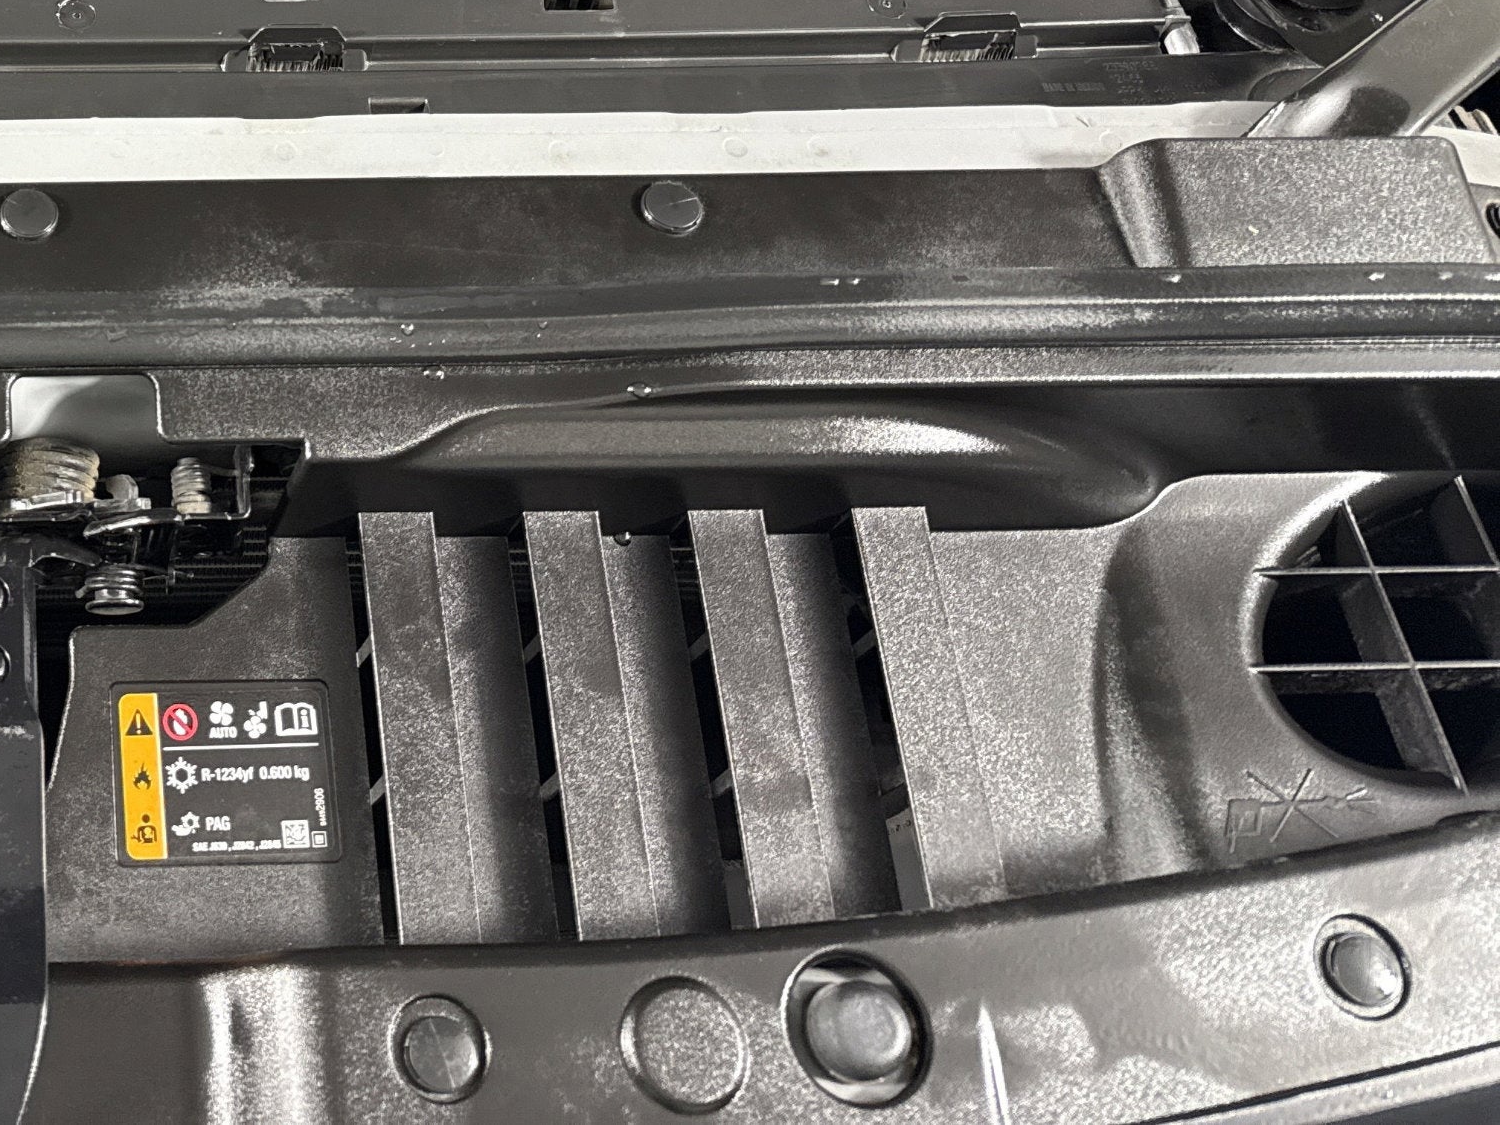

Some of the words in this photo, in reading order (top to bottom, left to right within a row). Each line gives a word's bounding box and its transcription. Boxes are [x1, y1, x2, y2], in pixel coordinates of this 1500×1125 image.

[209, 725, 238, 739] AUTO
[201, 766, 254, 784] R-1234yf
[259, 766, 292, 780] 0.600
[294, 765, 310, 781] kg
[205, 816, 231, 831] PAG
